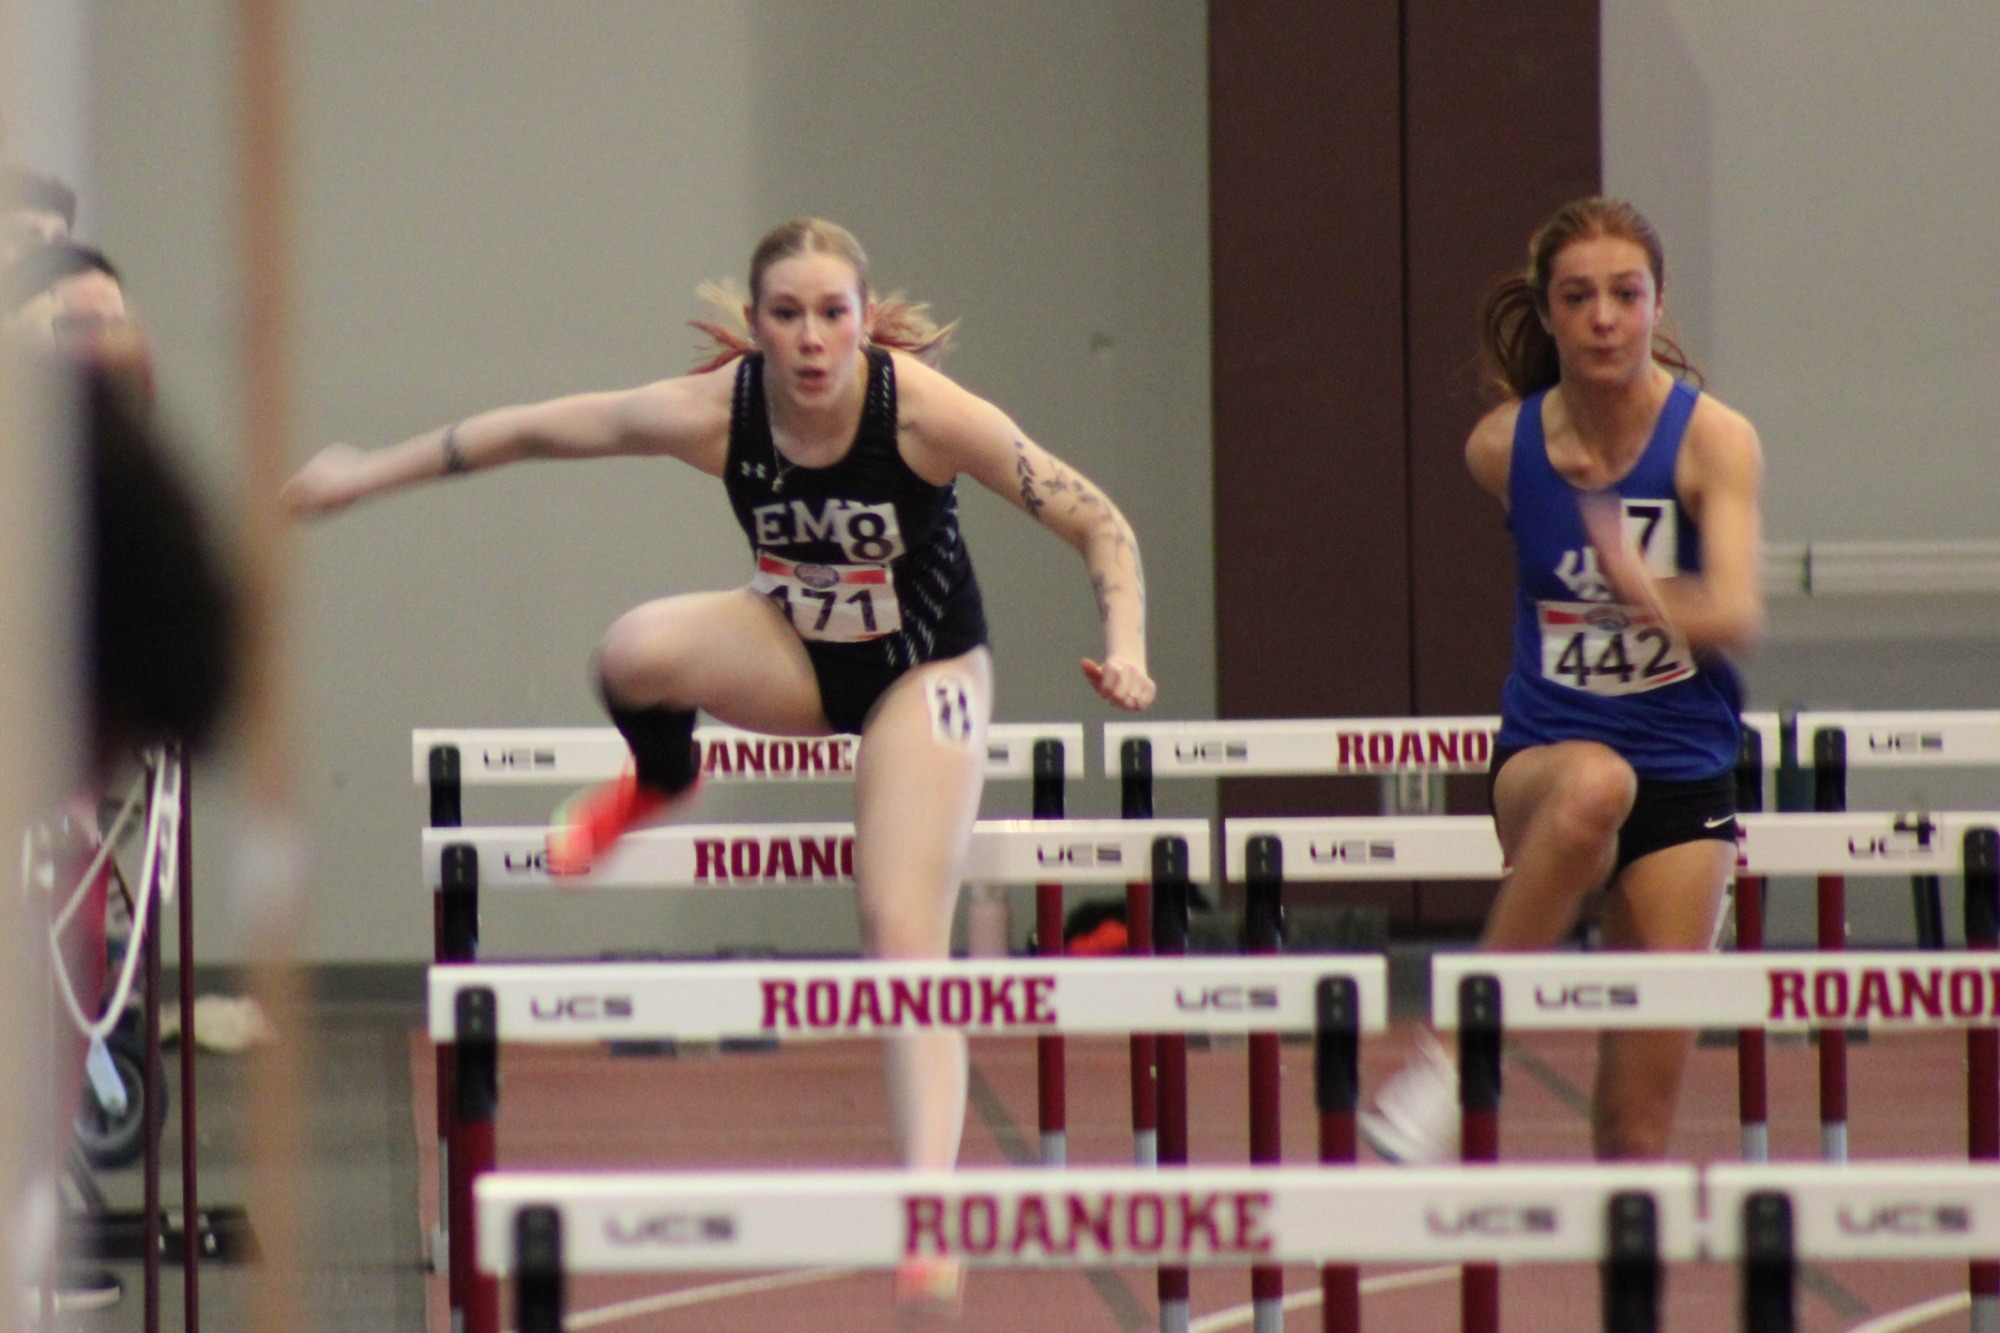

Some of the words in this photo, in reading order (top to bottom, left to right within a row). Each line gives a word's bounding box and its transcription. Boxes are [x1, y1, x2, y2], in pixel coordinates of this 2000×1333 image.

[753, 498, 866, 546] EM
[847, 512, 894, 561] 8
[1626, 505, 1663, 556] 7
[1554, 626, 1680, 686] 442
[692, 740, 854, 773] ANOKE
[1336, 731, 1500, 769] ROANO
[1037, 844, 1122, 866] UCS
[1310, 841, 1396, 864] UCS
[530, 995, 634, 1020] UCS
[760, 976, 1058, 1029] ROANOKE
[1175, 985, 1279, 1011] UCS
[1534, 983, 1639, 1009] UCS
[606, 1214, 738, 1243] UCS
[904, 1192, 1275, 1257] ROANOKE
[1426, 1207, 1557, 1236] UCS
[1838, 1205, 1973, 1233] UCS
